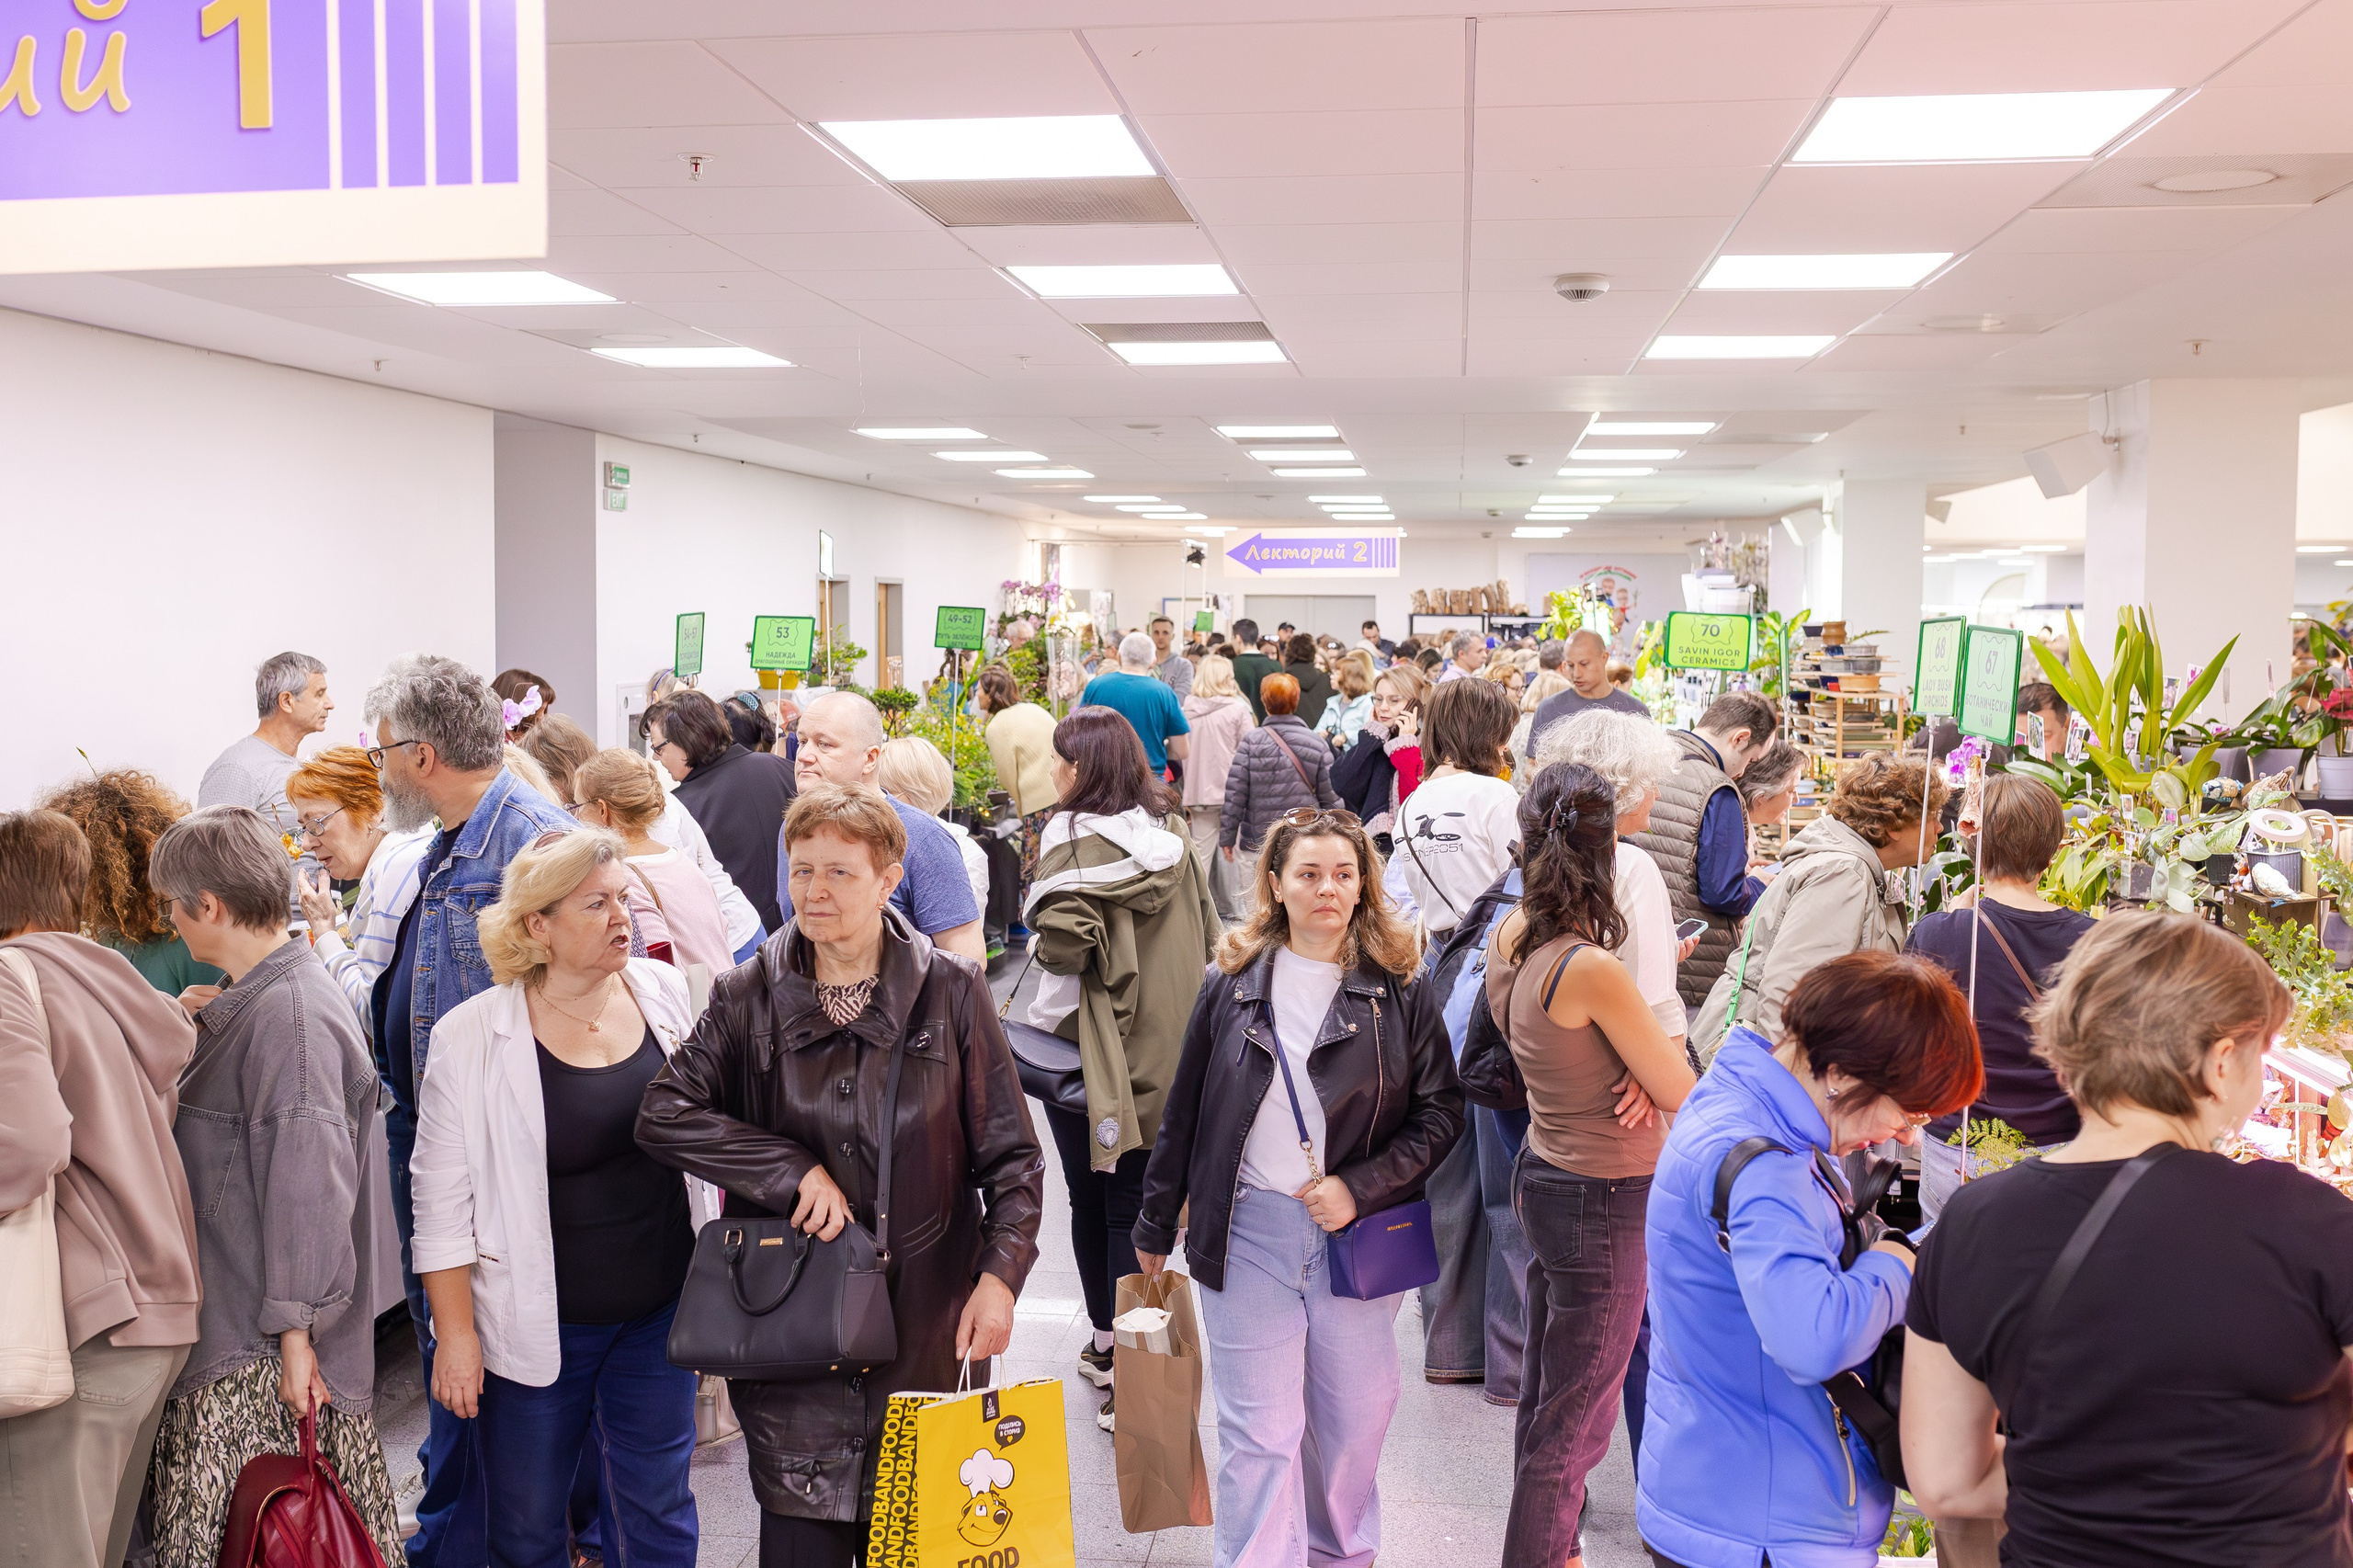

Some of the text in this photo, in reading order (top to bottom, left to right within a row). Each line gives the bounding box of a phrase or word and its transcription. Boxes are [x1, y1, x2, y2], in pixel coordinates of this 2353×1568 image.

[201, 0, 273, 129] 1
[1245, 541, 1368, 565] Лекторий 2
[948, 614, 972, 624] 49-52
[776, 626, 790, 639] 53
[1701, 624, 1721, 637] 70
[1678, 646, 1741, 657] SAVIN IGOR
[1935, 637, 1947, 659] 68
[766, 651, 796, 659] НАДЕЖДА
[1681, 656, 1736, 666] CERAMICS
[1985, 650, 1999, 675] 67
[1922, 679, 1953, 692] LADY BUSH
[1924, 695, 1948, 707] ORCHIDS
[1981, 713, 1993, 728] ЧАЙ
